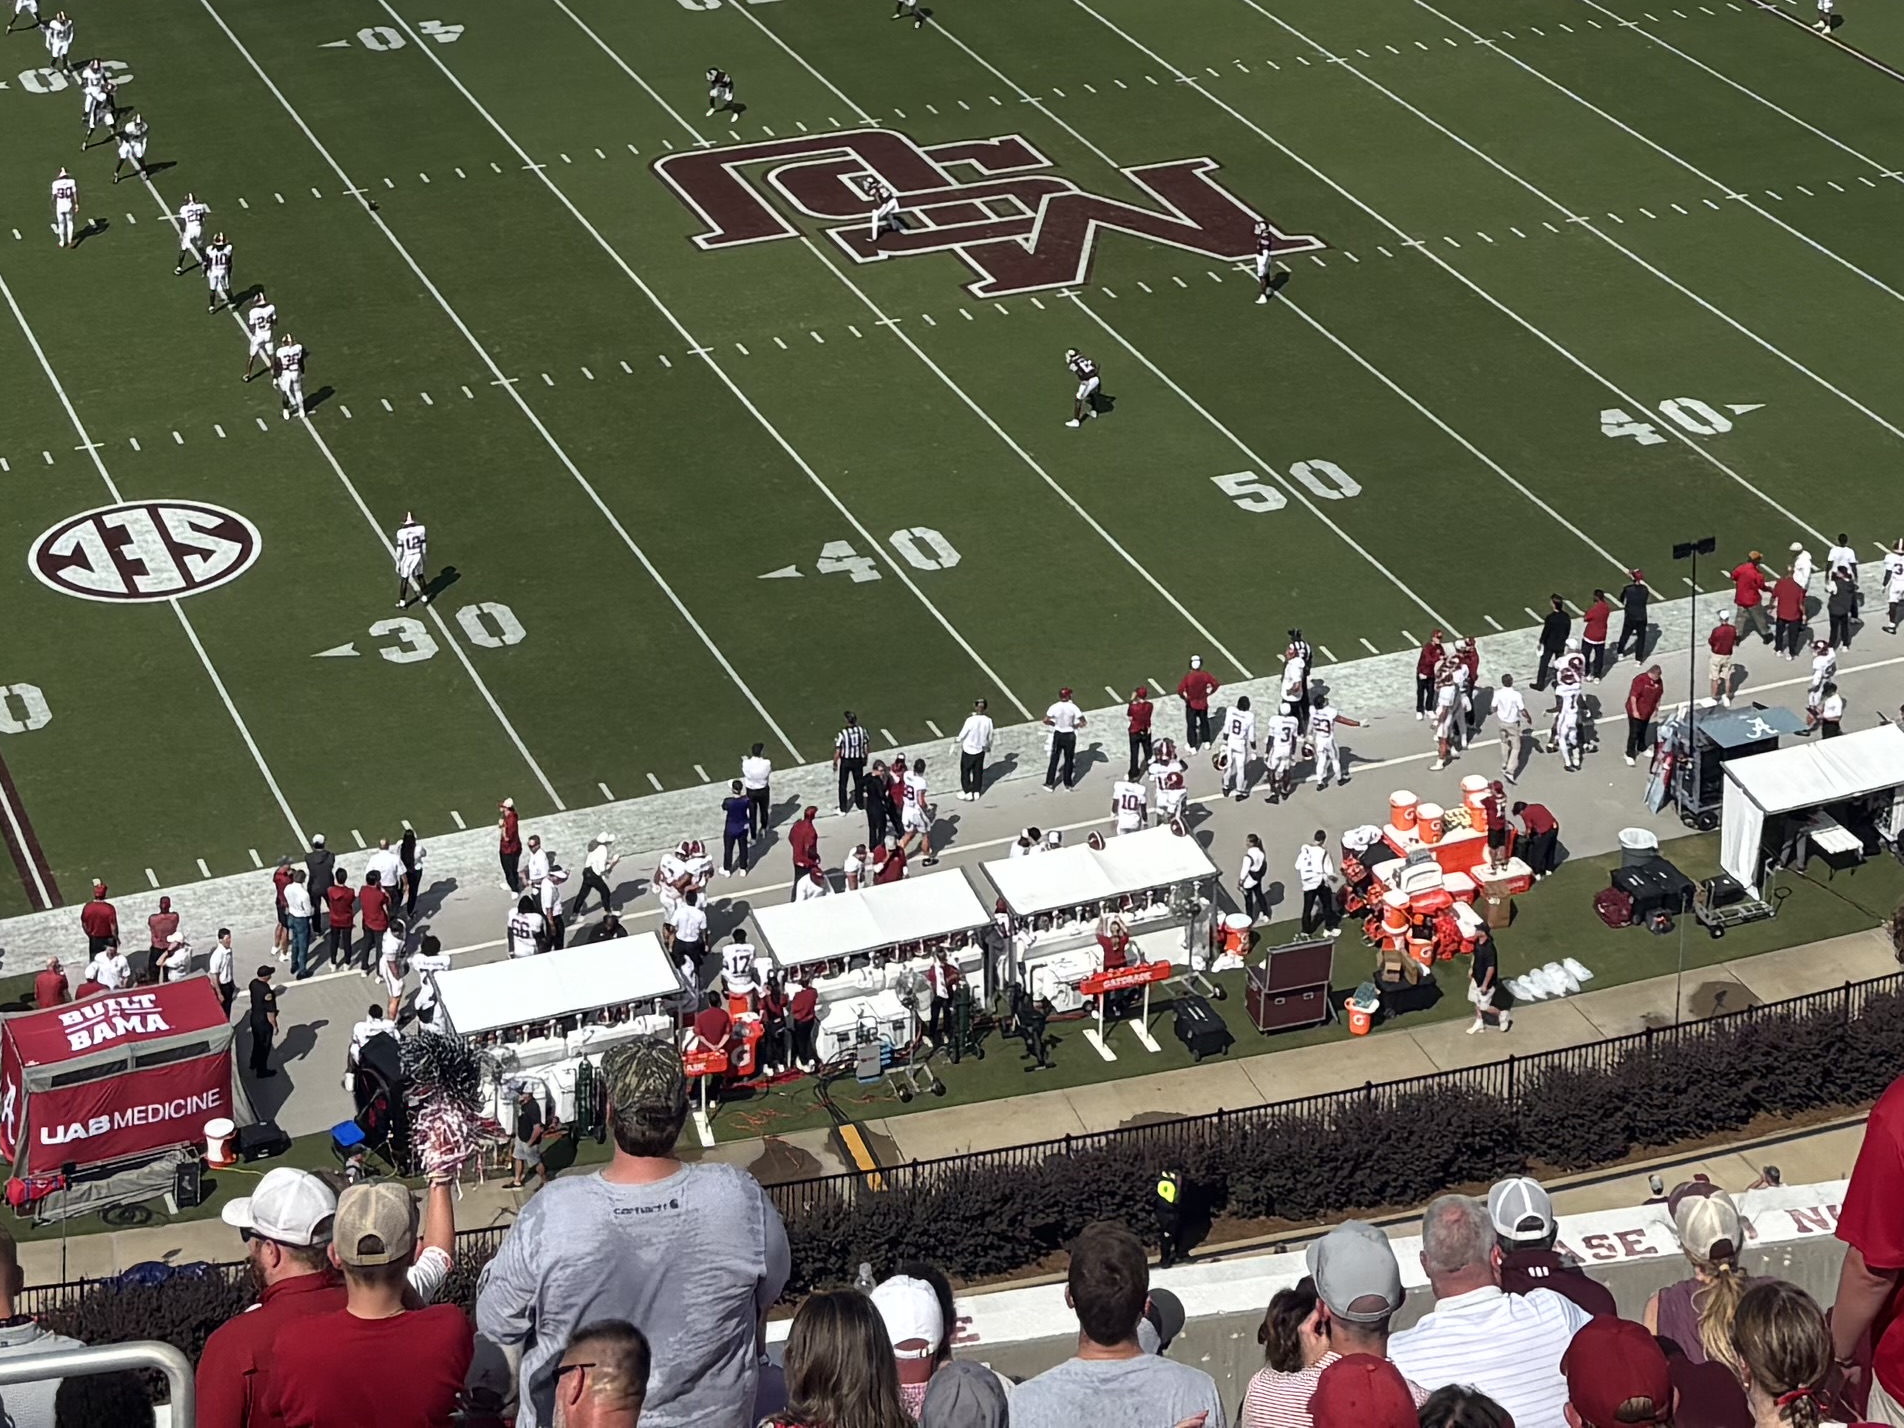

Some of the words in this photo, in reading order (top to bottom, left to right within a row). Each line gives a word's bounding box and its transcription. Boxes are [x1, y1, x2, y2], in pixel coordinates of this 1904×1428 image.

[354, 19, 467, 52] 40
[1600, 396, 1736, 447] 40
[1211, 458, 1363, 515] 50
[46, 506, 228, 595] SEC
[814, 525, 962, 583] 40
[369, 601, 527, 665] 30
[1232, 719, 1242, 735] 8
[1281, 727, 1291, 743] 3
[1121, 794, 1139, 811] 10
[511, 920, 531, 939] 66
[731, 954, 749, 973] 17
[1102, 970, 1153, 989] GATORADE
[58, 993, 156, 1027] BUILT
[67, 1013, 170, 1052] BAMA
[40, 1114, 111, 1145] UAB
[113, 1088, 221, 1130] MEDICINE
